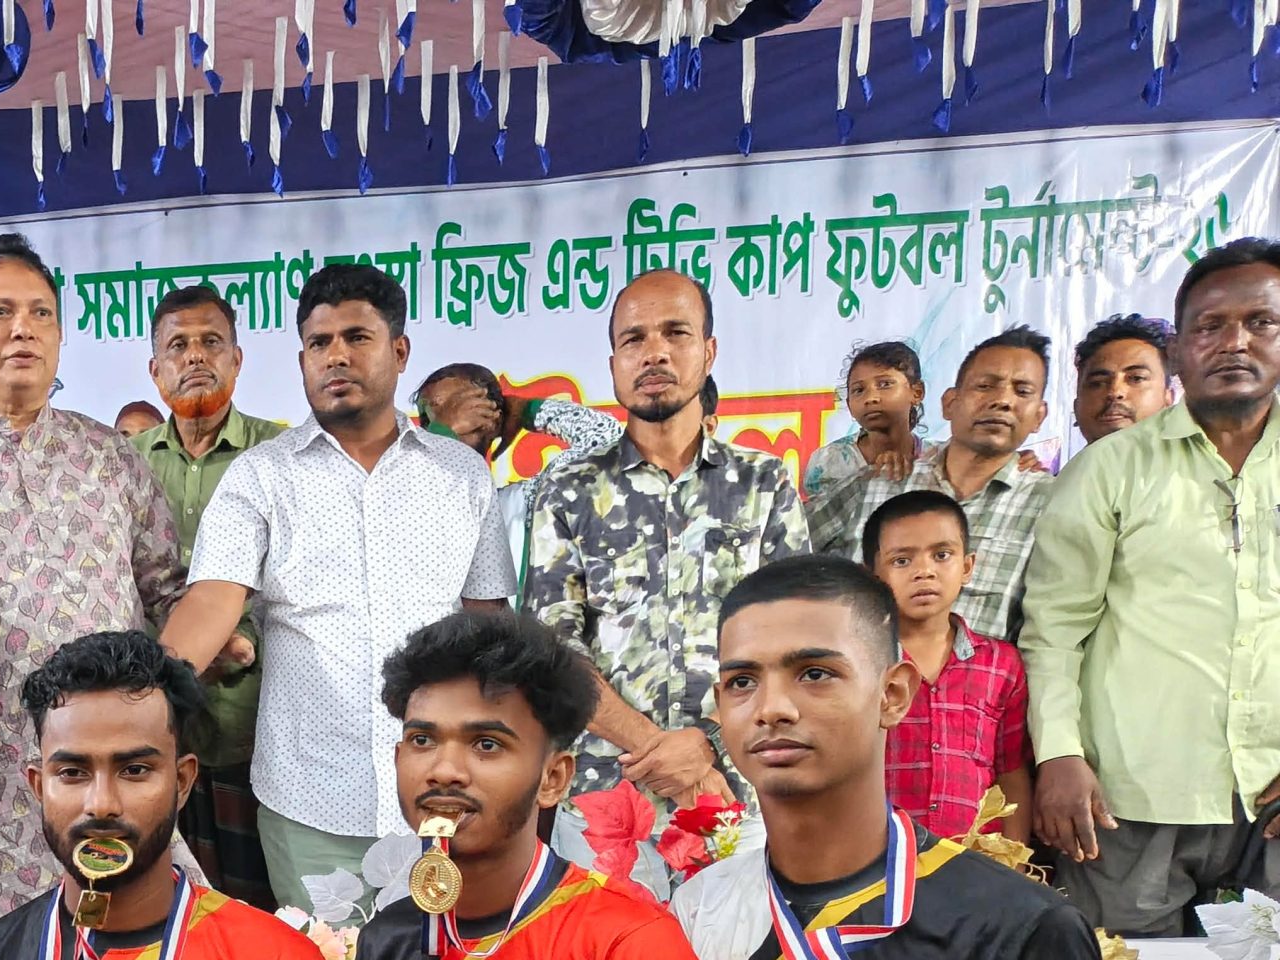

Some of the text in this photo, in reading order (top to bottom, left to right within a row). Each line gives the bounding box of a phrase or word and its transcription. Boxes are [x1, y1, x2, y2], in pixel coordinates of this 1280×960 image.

[431, 221, 531, 327] ফ্রিজ
[541, 236, 613, 310] এন্ড
[725, 212, 815, 297] কাপ
[825, 193, 970, 319] ফুটবল
